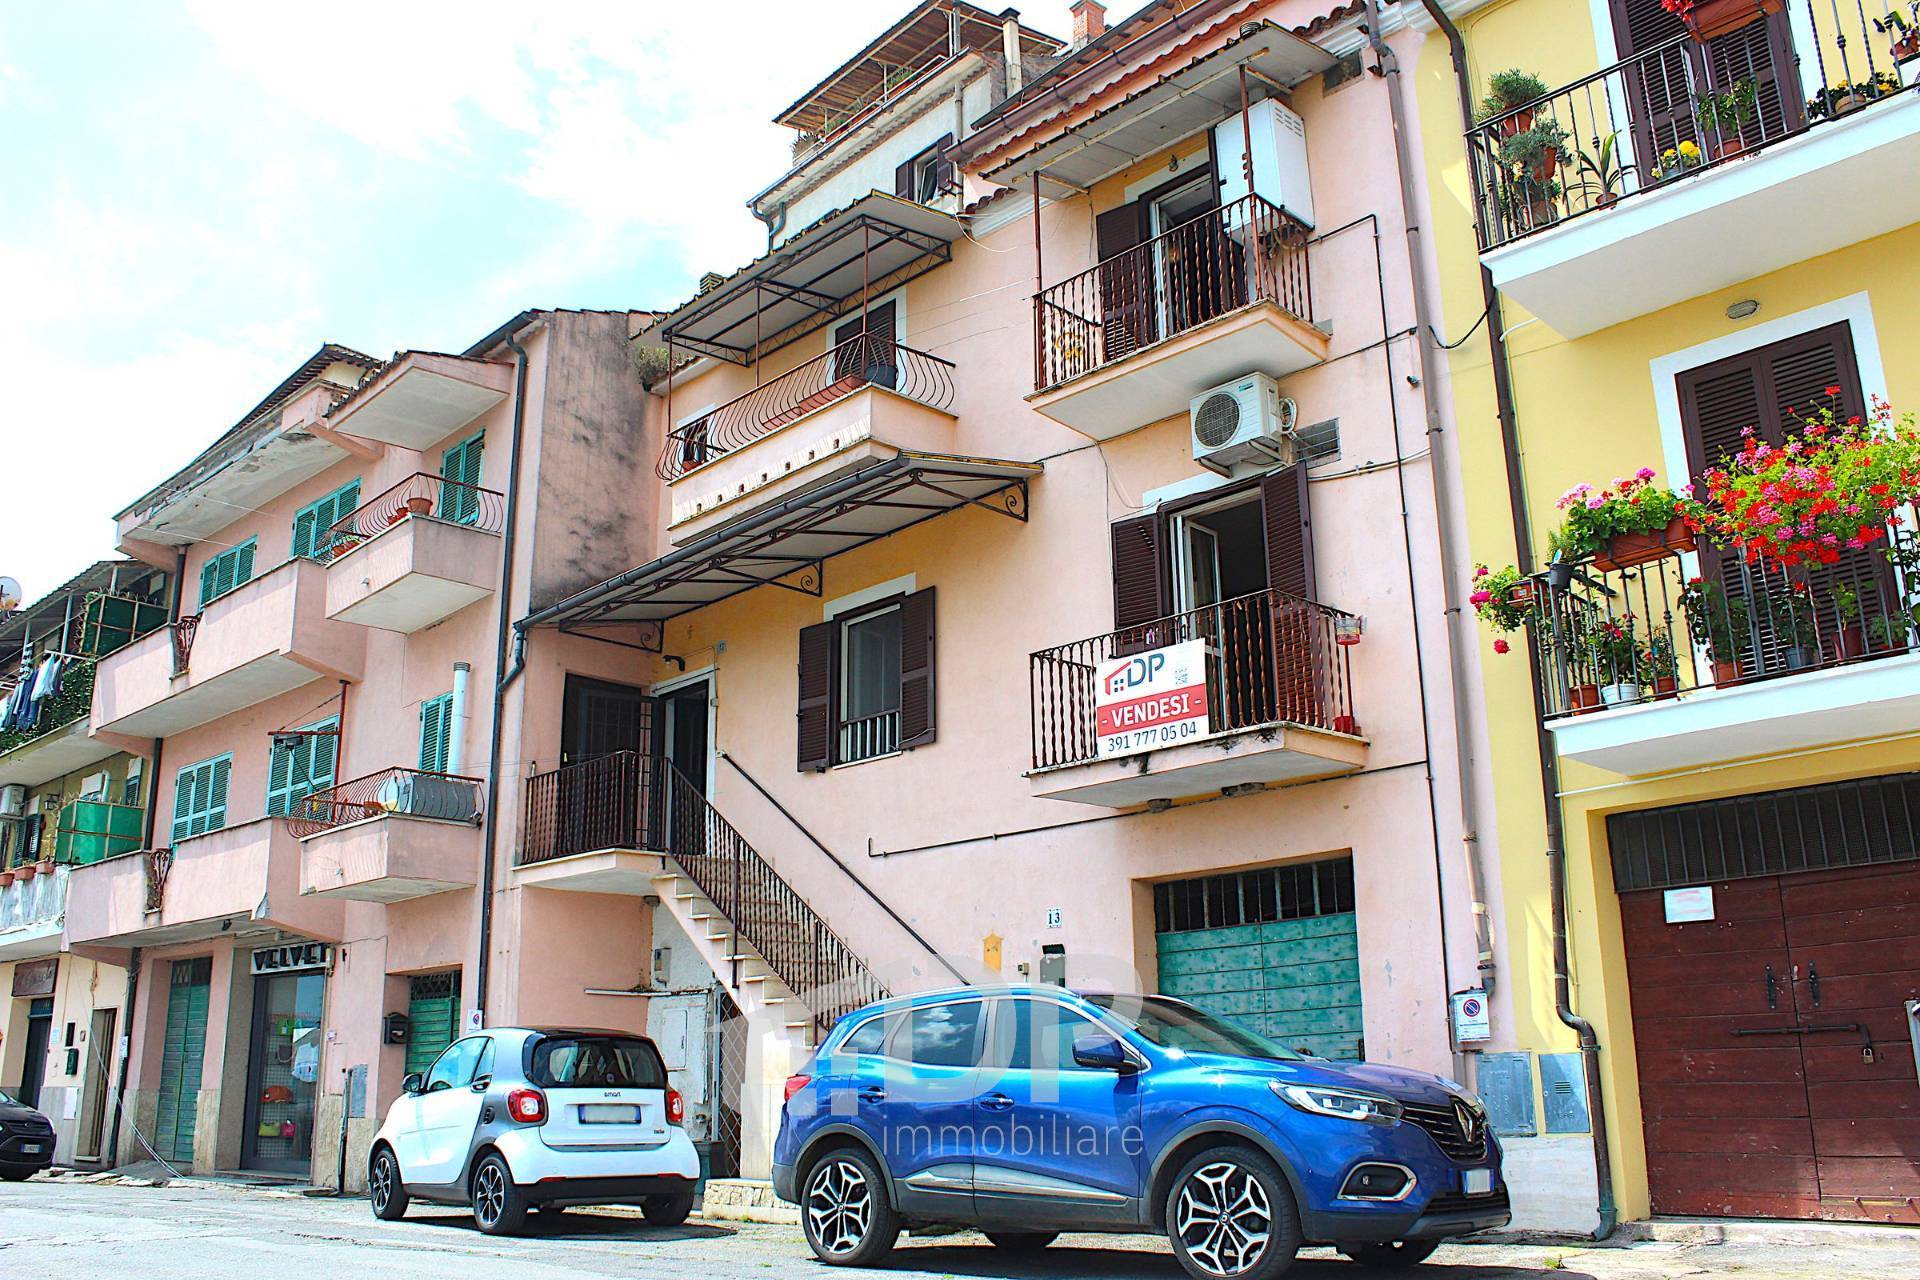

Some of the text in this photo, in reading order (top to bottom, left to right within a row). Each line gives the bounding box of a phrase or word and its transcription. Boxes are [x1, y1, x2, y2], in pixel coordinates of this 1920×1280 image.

[1127, 652, 1165, 687] DP
[1112, 694, 1190, 728] VENDESI
[1108, 721, 1197, 752] 391 777 05 04
[1048, 912, 1061, 925] 13
